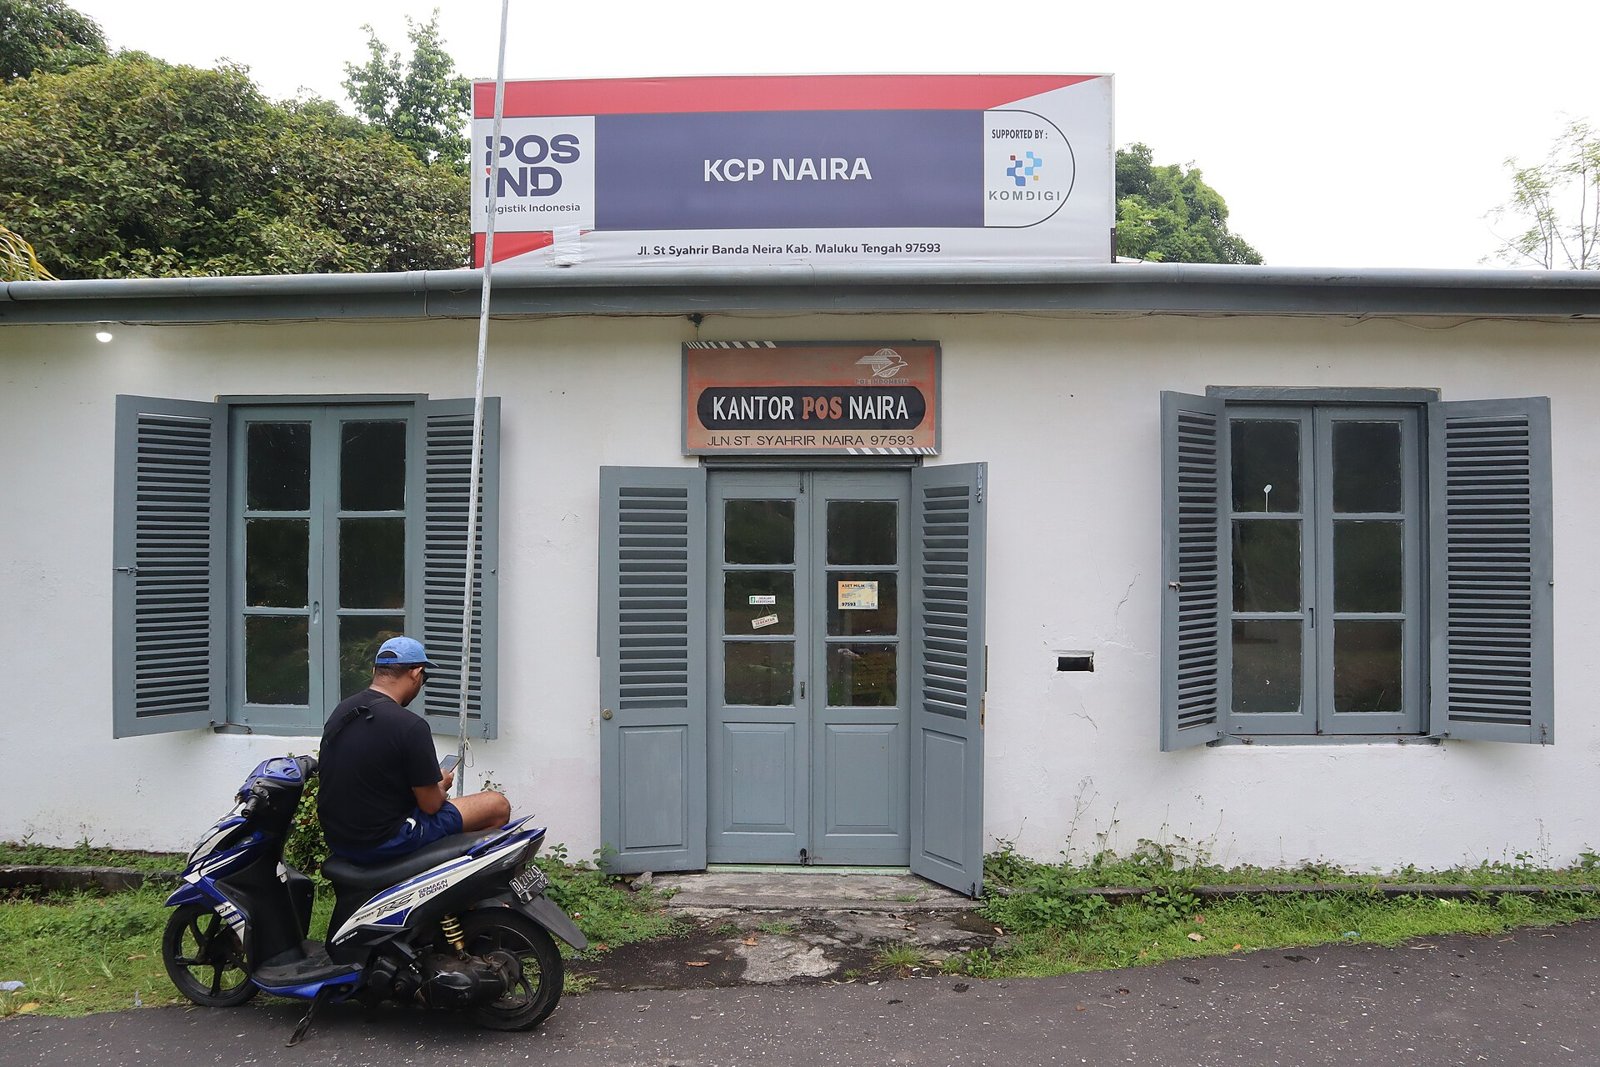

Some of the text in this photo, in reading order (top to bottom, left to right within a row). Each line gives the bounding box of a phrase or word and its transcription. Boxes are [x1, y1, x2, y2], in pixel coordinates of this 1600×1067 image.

[991, 129, 1033, 139] SUPPORTED
[1034, 129, 1044, 139] BY
[486, 134, 580, 165] POS
[704, 157, 873, 182] KCP NAIRA
[989, 190, 1060, 201] KOMDIGI
[529, 203, 581, 213] Indonesia
[637, 243, 941, 257] Jl. St Syahrir Banda Neira Kab. Maluku Tengah 97593
[713, 395, 909, 420] KANTOR POS NAIRA
[756, 435, 816, 446] SYAHRIR
[822, 435, 864, 446] NAIRA
[870, 435, 915, 446] 97593
[418, 879, 448, 894] SEMAKIN
